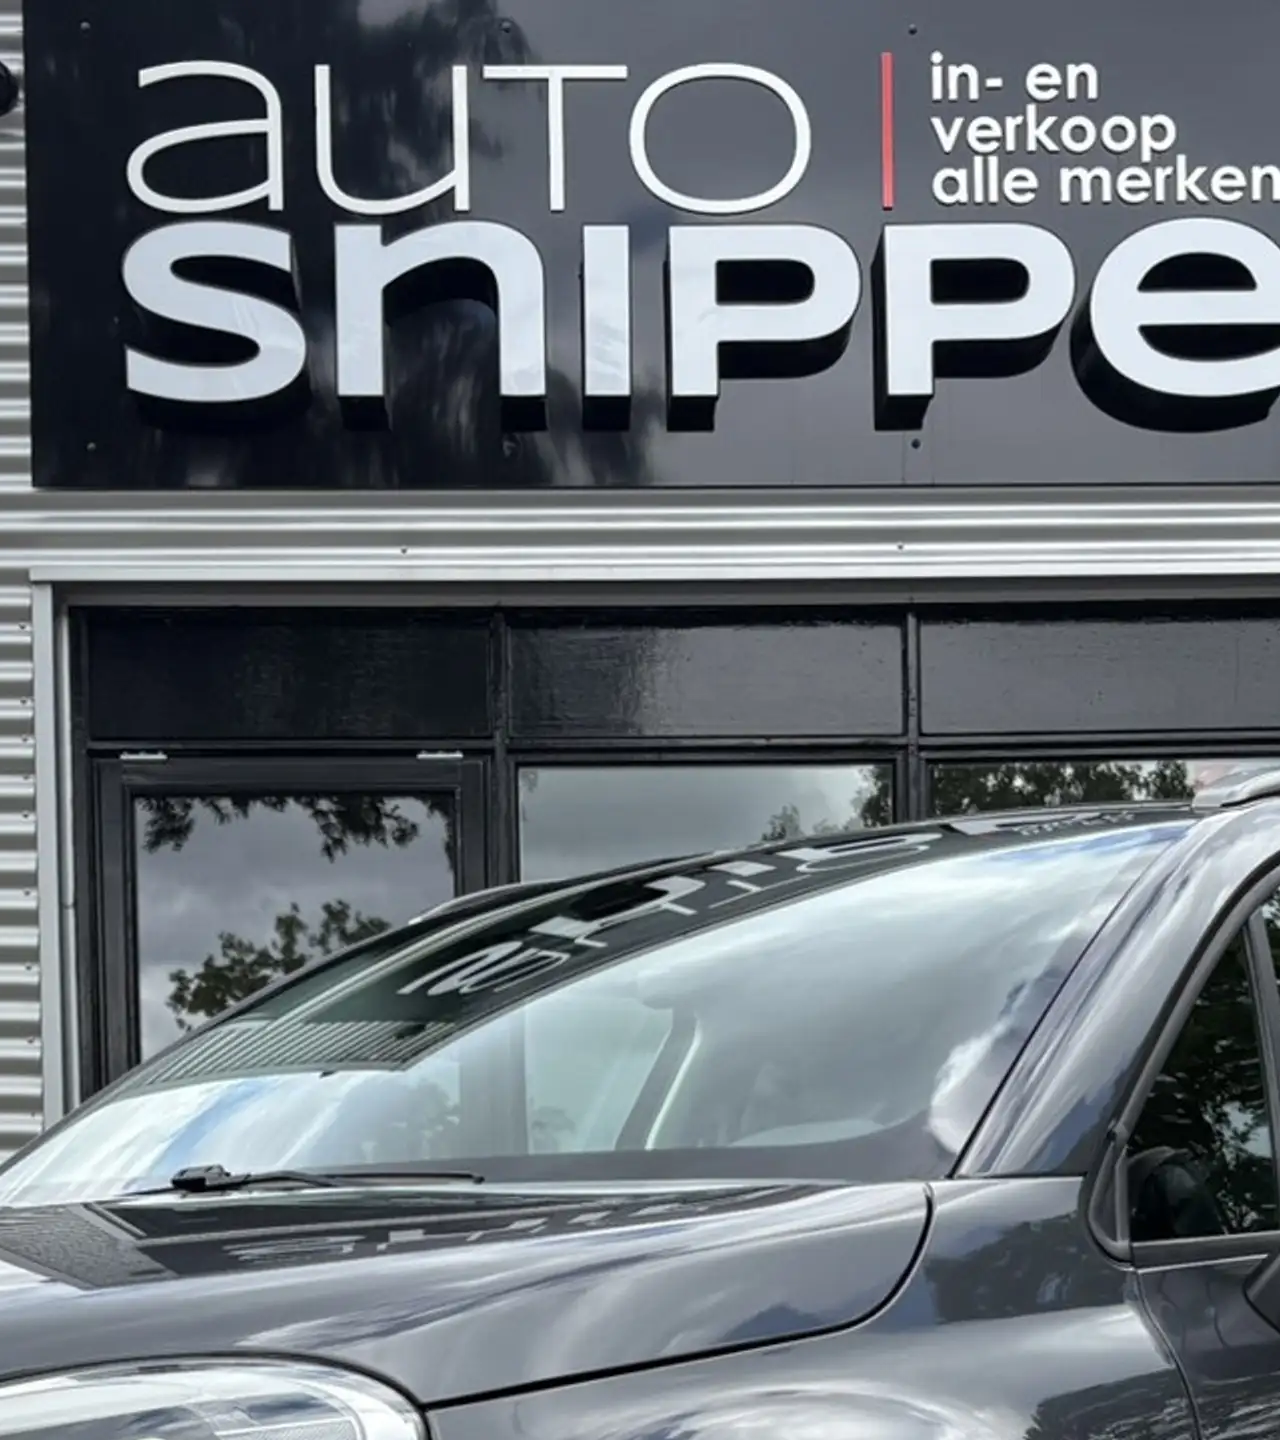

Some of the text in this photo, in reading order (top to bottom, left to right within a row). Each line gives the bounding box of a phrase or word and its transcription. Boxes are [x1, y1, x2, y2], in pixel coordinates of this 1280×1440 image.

[931, 51, 1099, 101] in- en
[931, 104, 1177, 163] verkoop
[932, 155, 1040, 205] alle
